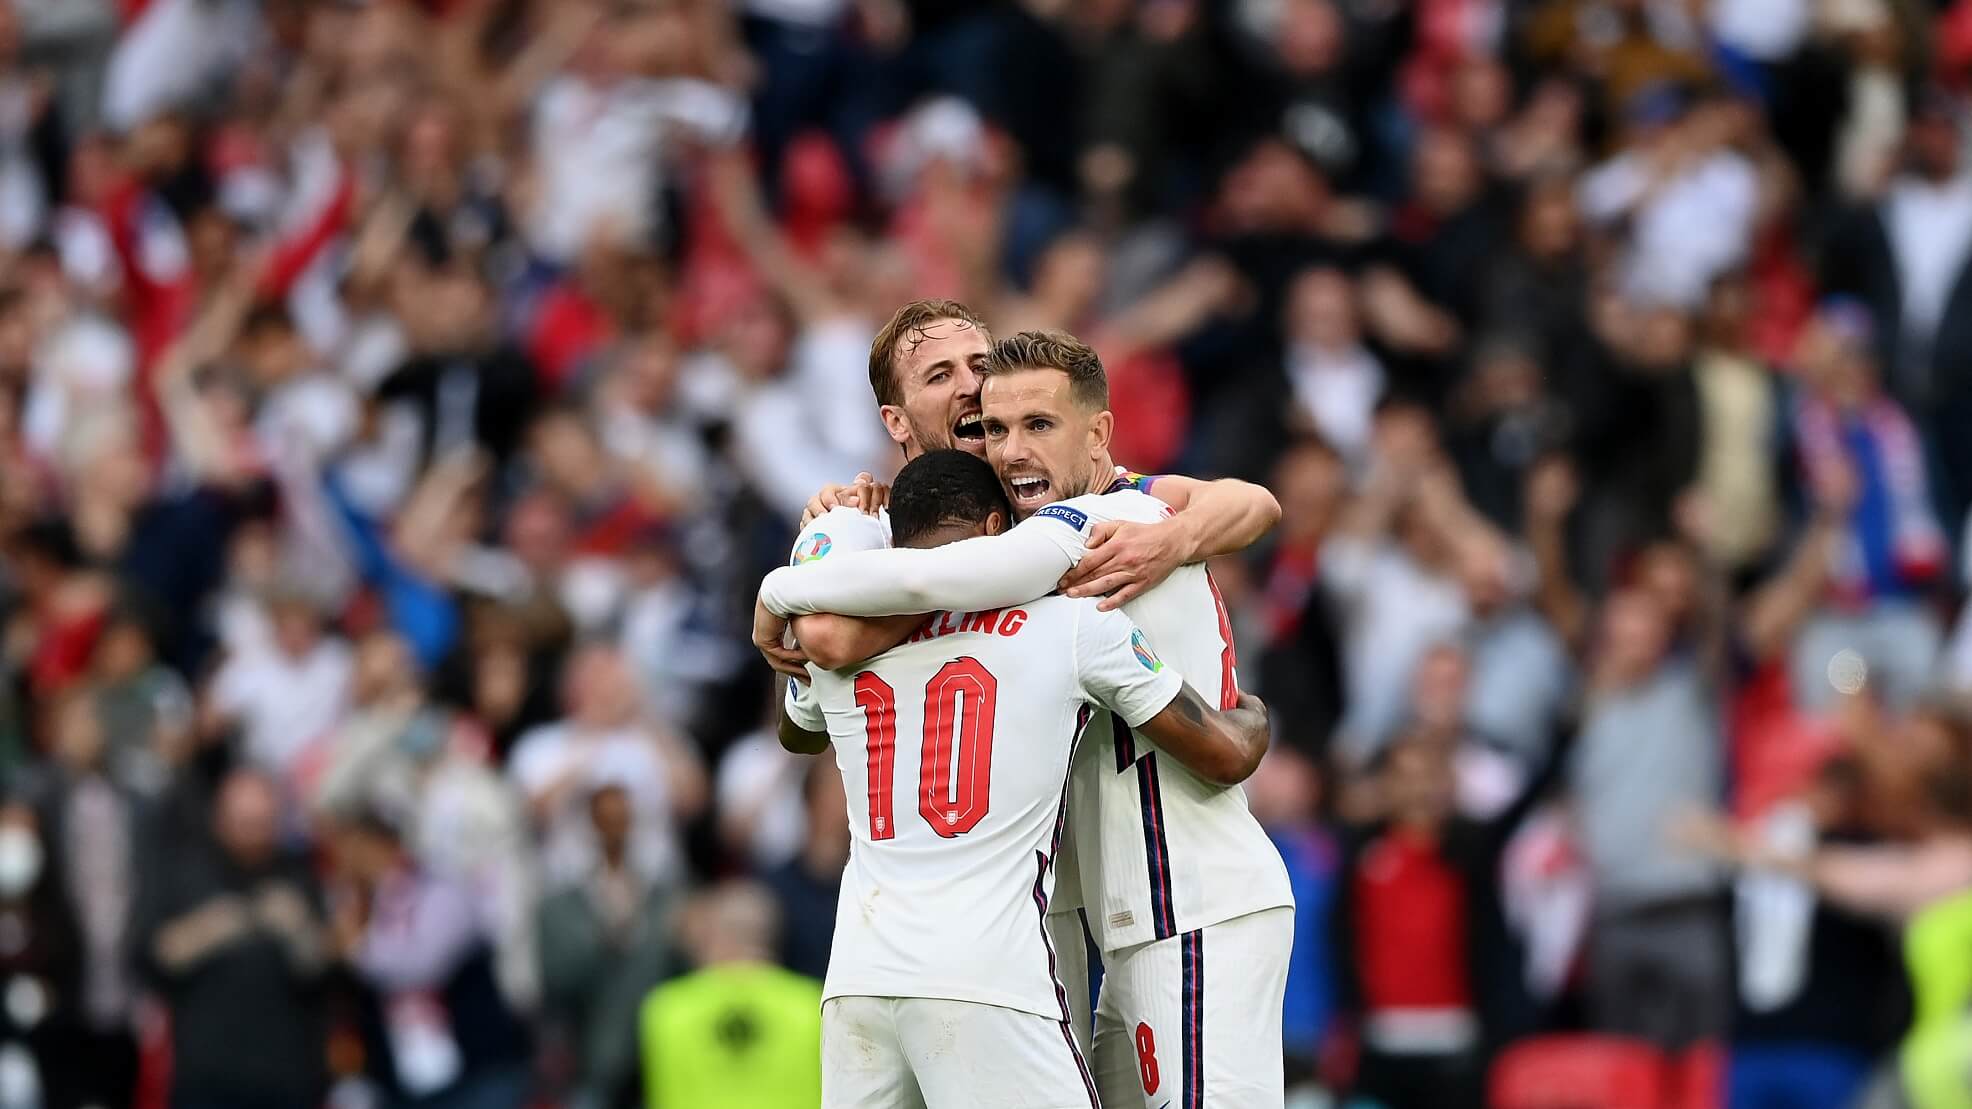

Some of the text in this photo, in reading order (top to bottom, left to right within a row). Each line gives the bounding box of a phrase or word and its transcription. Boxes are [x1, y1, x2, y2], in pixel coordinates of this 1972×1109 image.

[1038, 507, 1086, 527] RESPECT
[911, 609, 1028, 643] RLING
[853, 655, 998, 841] 10
[1135, 1021, 1161, 1097] 8
